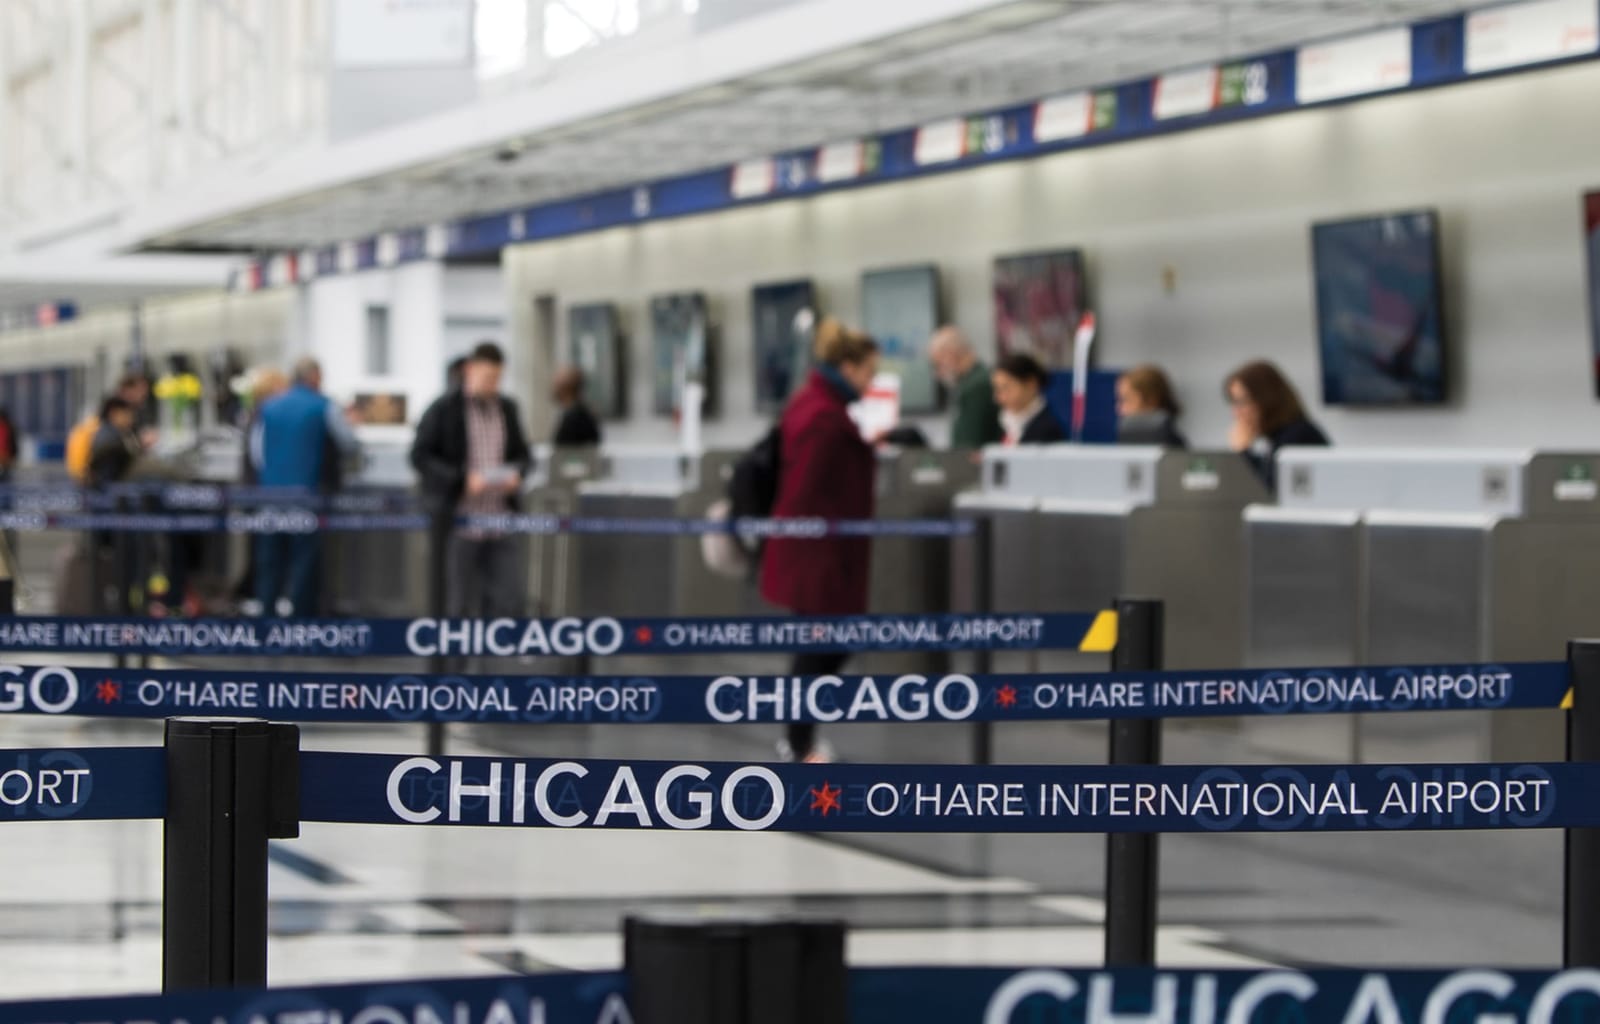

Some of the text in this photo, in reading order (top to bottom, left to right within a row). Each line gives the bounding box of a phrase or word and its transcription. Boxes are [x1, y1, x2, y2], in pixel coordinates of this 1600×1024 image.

[64, 623, 261, 647] INTERNATIONAL
[267, 625, 370, 647] AIRPORT
[406, 617, 623, 655] CHICAGO
[664, 622, 753, 647] O'HARE
[759, 621, 942, 645] INTERNATIONAL
[948, 619, 1044, 642] AIRPORT
[138, 680, 259, 710] O'HARE
[269, 682, 519, 713] INTERNATIONAL
[527, 686, 658, 712] AIRPORT
[705, 674, 980, 723] CHICAGO
[1034, 682, 1145, 709] O'HARE
[1154, 677, 1385, 708] INTERNATIONAL
[1392, 673, 1512, 699] AIRPORT
[386, 757, 1550, 831] CHICAGO O'HARE INTERNATIONAL AIRPORT
